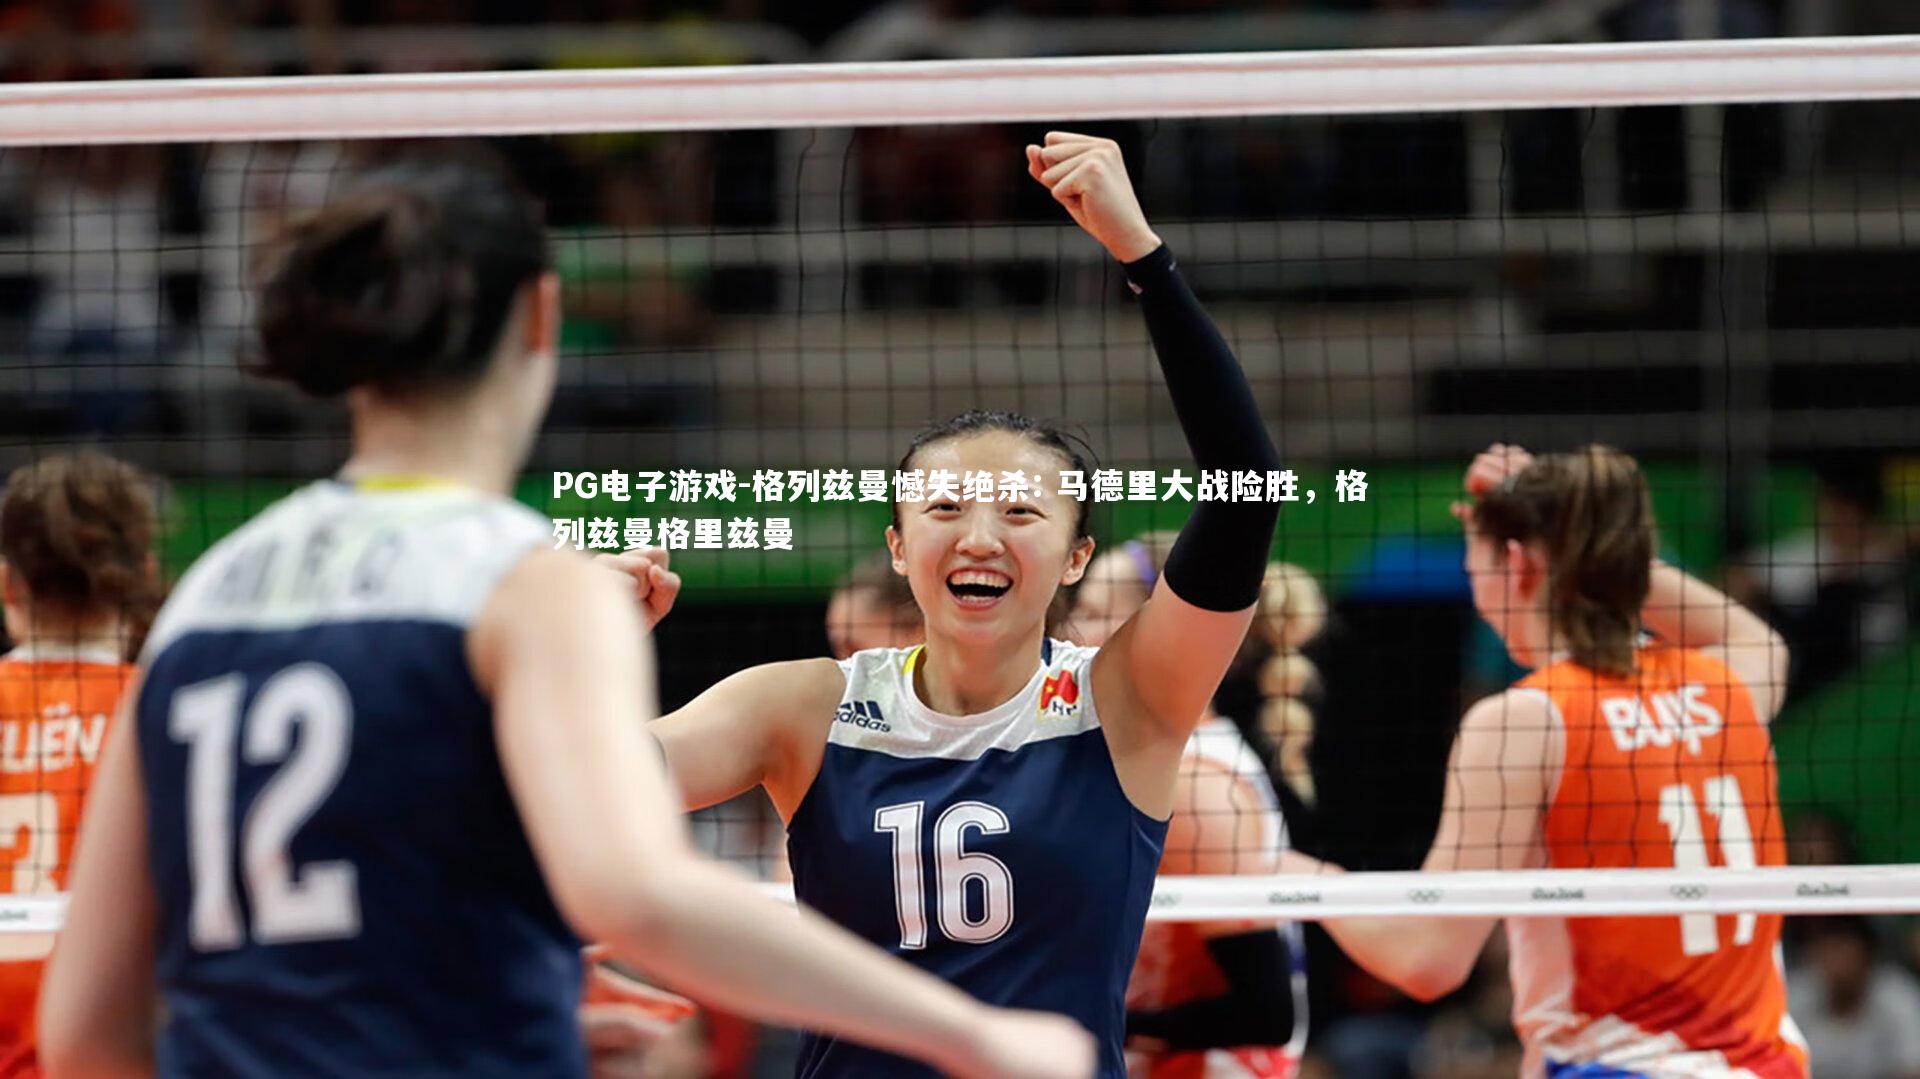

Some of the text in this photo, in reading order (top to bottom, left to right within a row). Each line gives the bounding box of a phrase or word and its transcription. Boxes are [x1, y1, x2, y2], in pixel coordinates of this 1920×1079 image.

[168, 661, 362, 952] 12
[874, 800, 1015, 950] 16
[1657, 774, 1758, 957] 11
